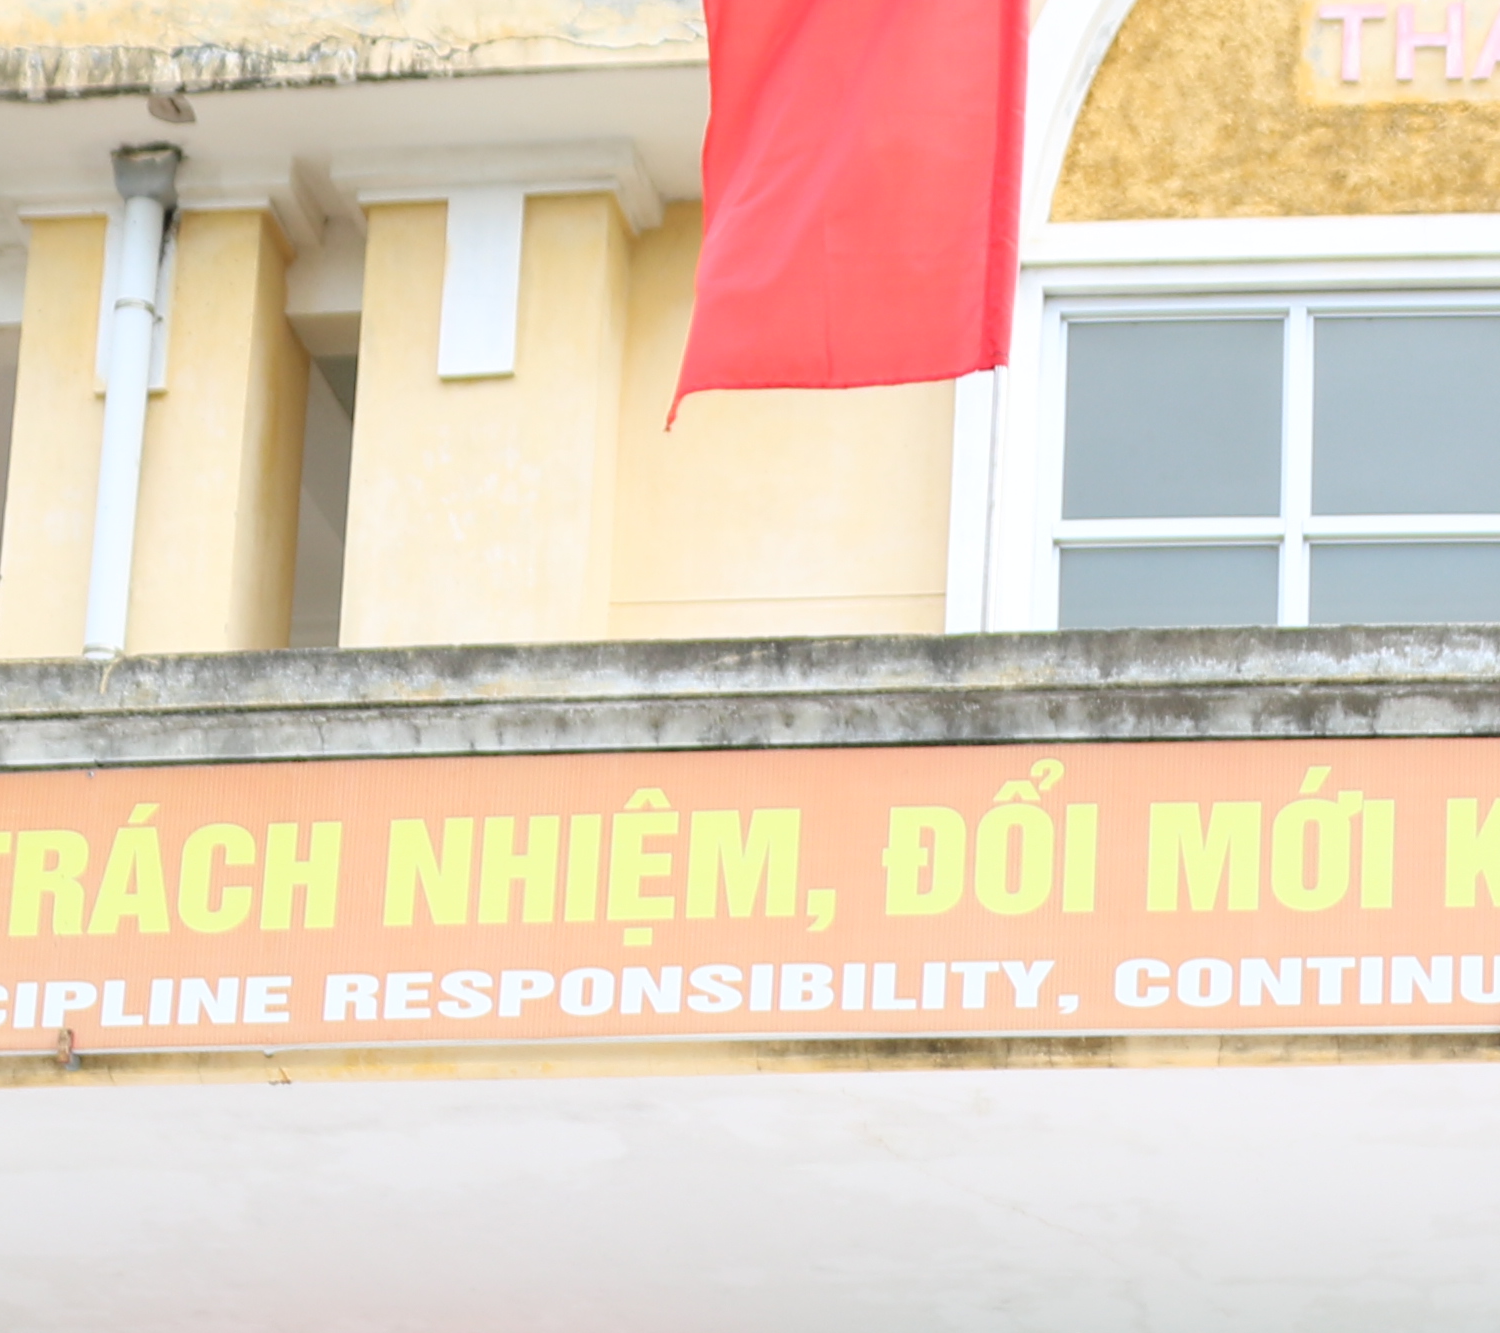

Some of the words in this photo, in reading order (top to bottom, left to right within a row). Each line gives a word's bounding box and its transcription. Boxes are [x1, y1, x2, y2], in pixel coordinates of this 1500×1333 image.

[383, 788, 839, 948] NHIỆM,
[882, 759, 1099, 917] ĐỔI
[1147, 766, 1396, 913] MỚI
[323, 959, 1080, 1026] RESPONSIBILITY,
